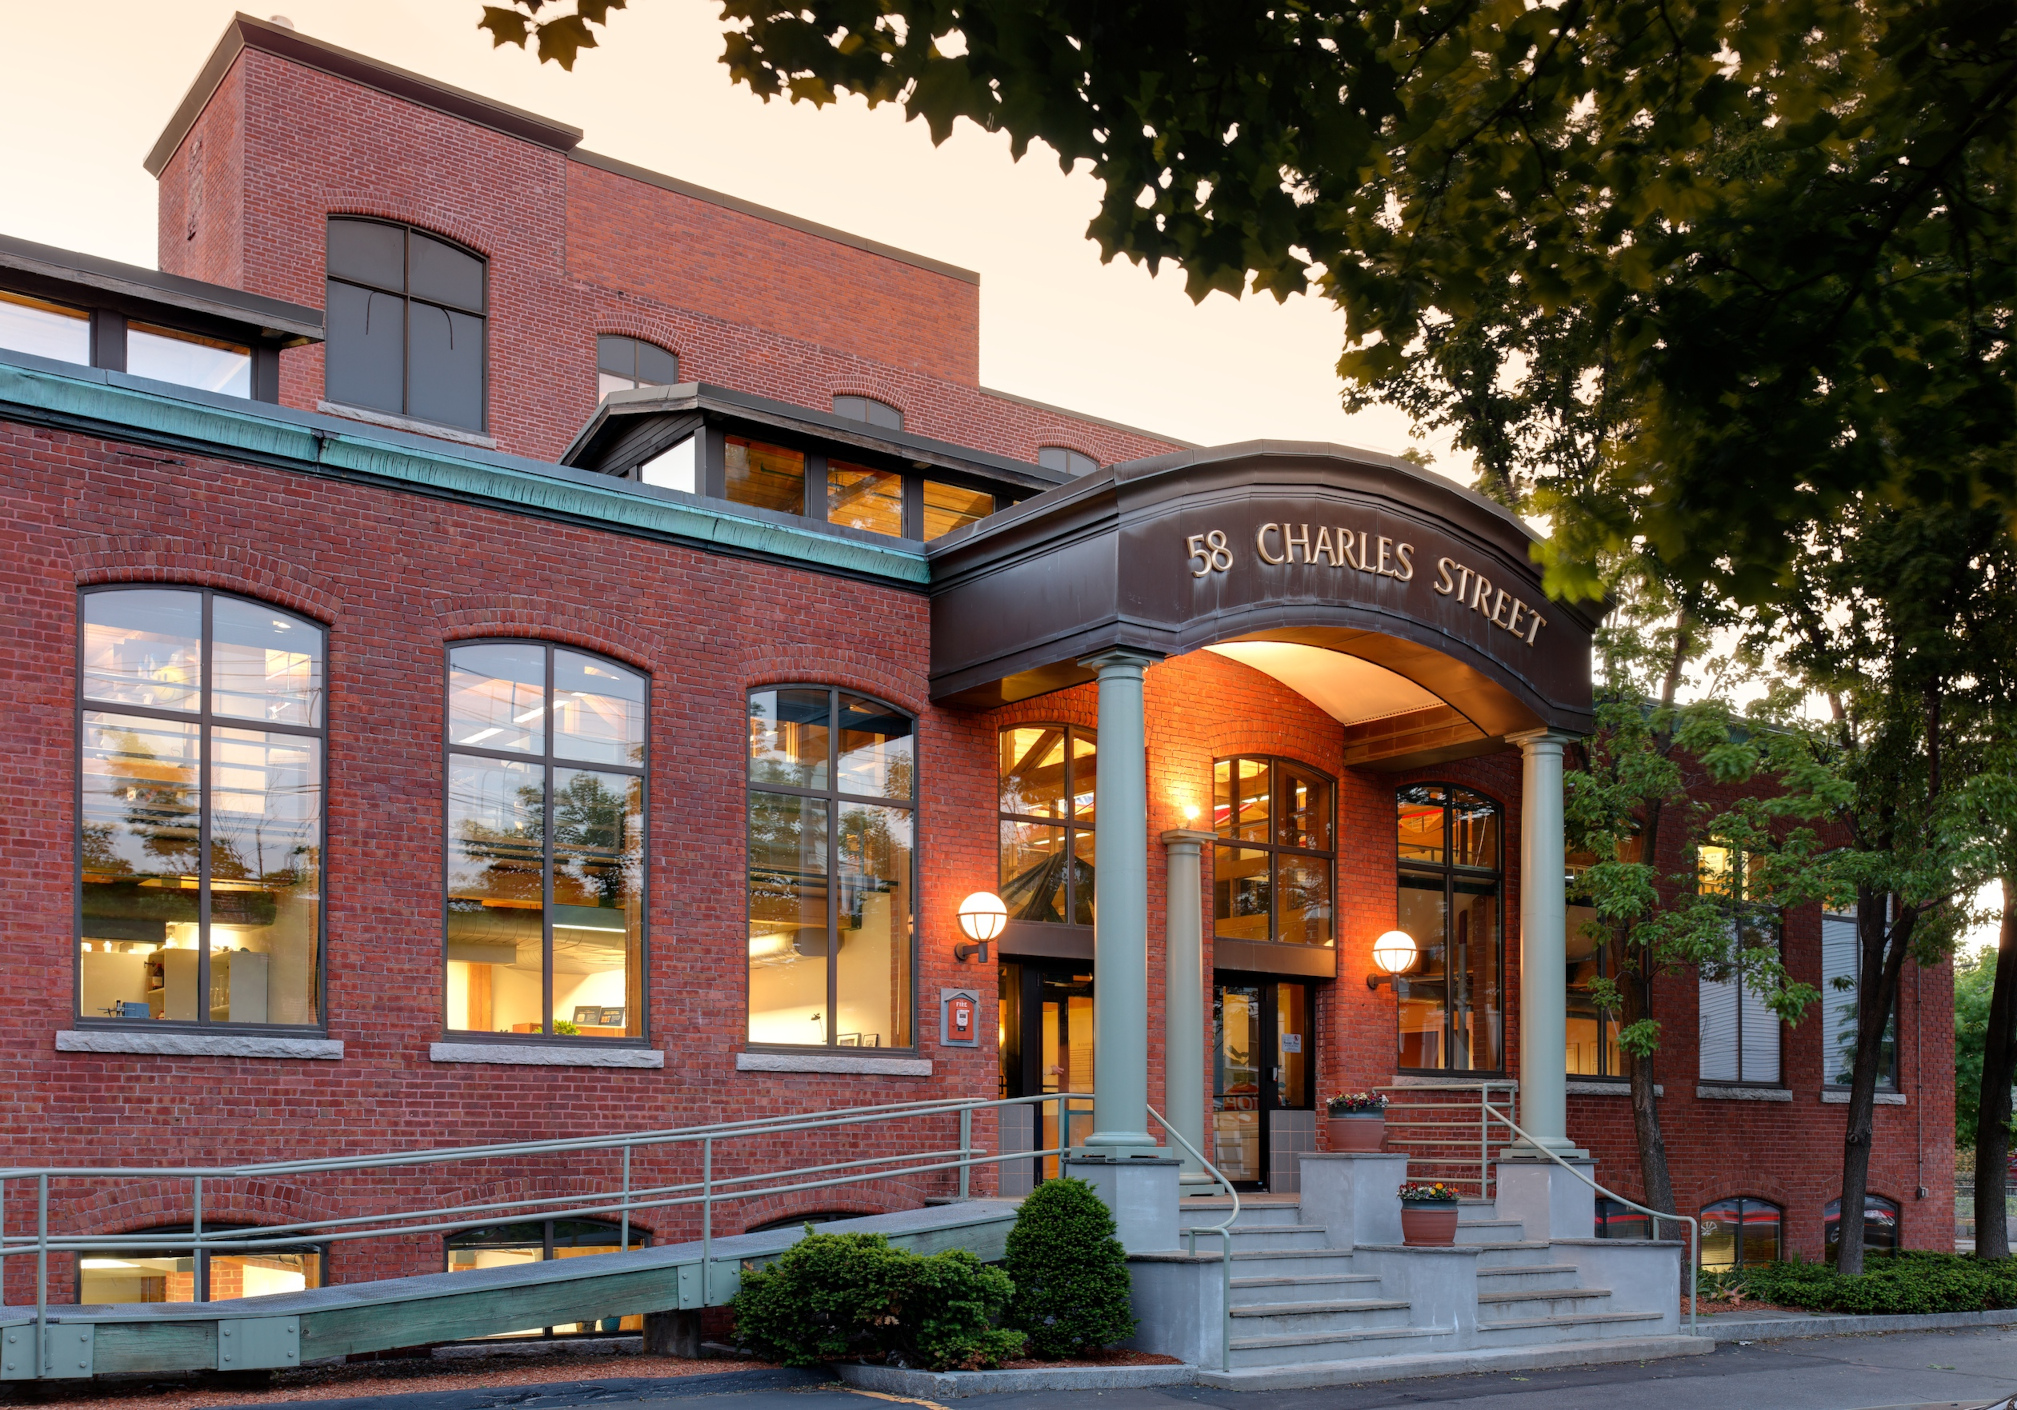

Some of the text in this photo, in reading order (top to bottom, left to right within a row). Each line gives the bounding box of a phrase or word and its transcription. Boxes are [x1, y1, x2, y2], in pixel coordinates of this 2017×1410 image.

[1186, 522, 1548, 647] 58 CHARLES STREET
